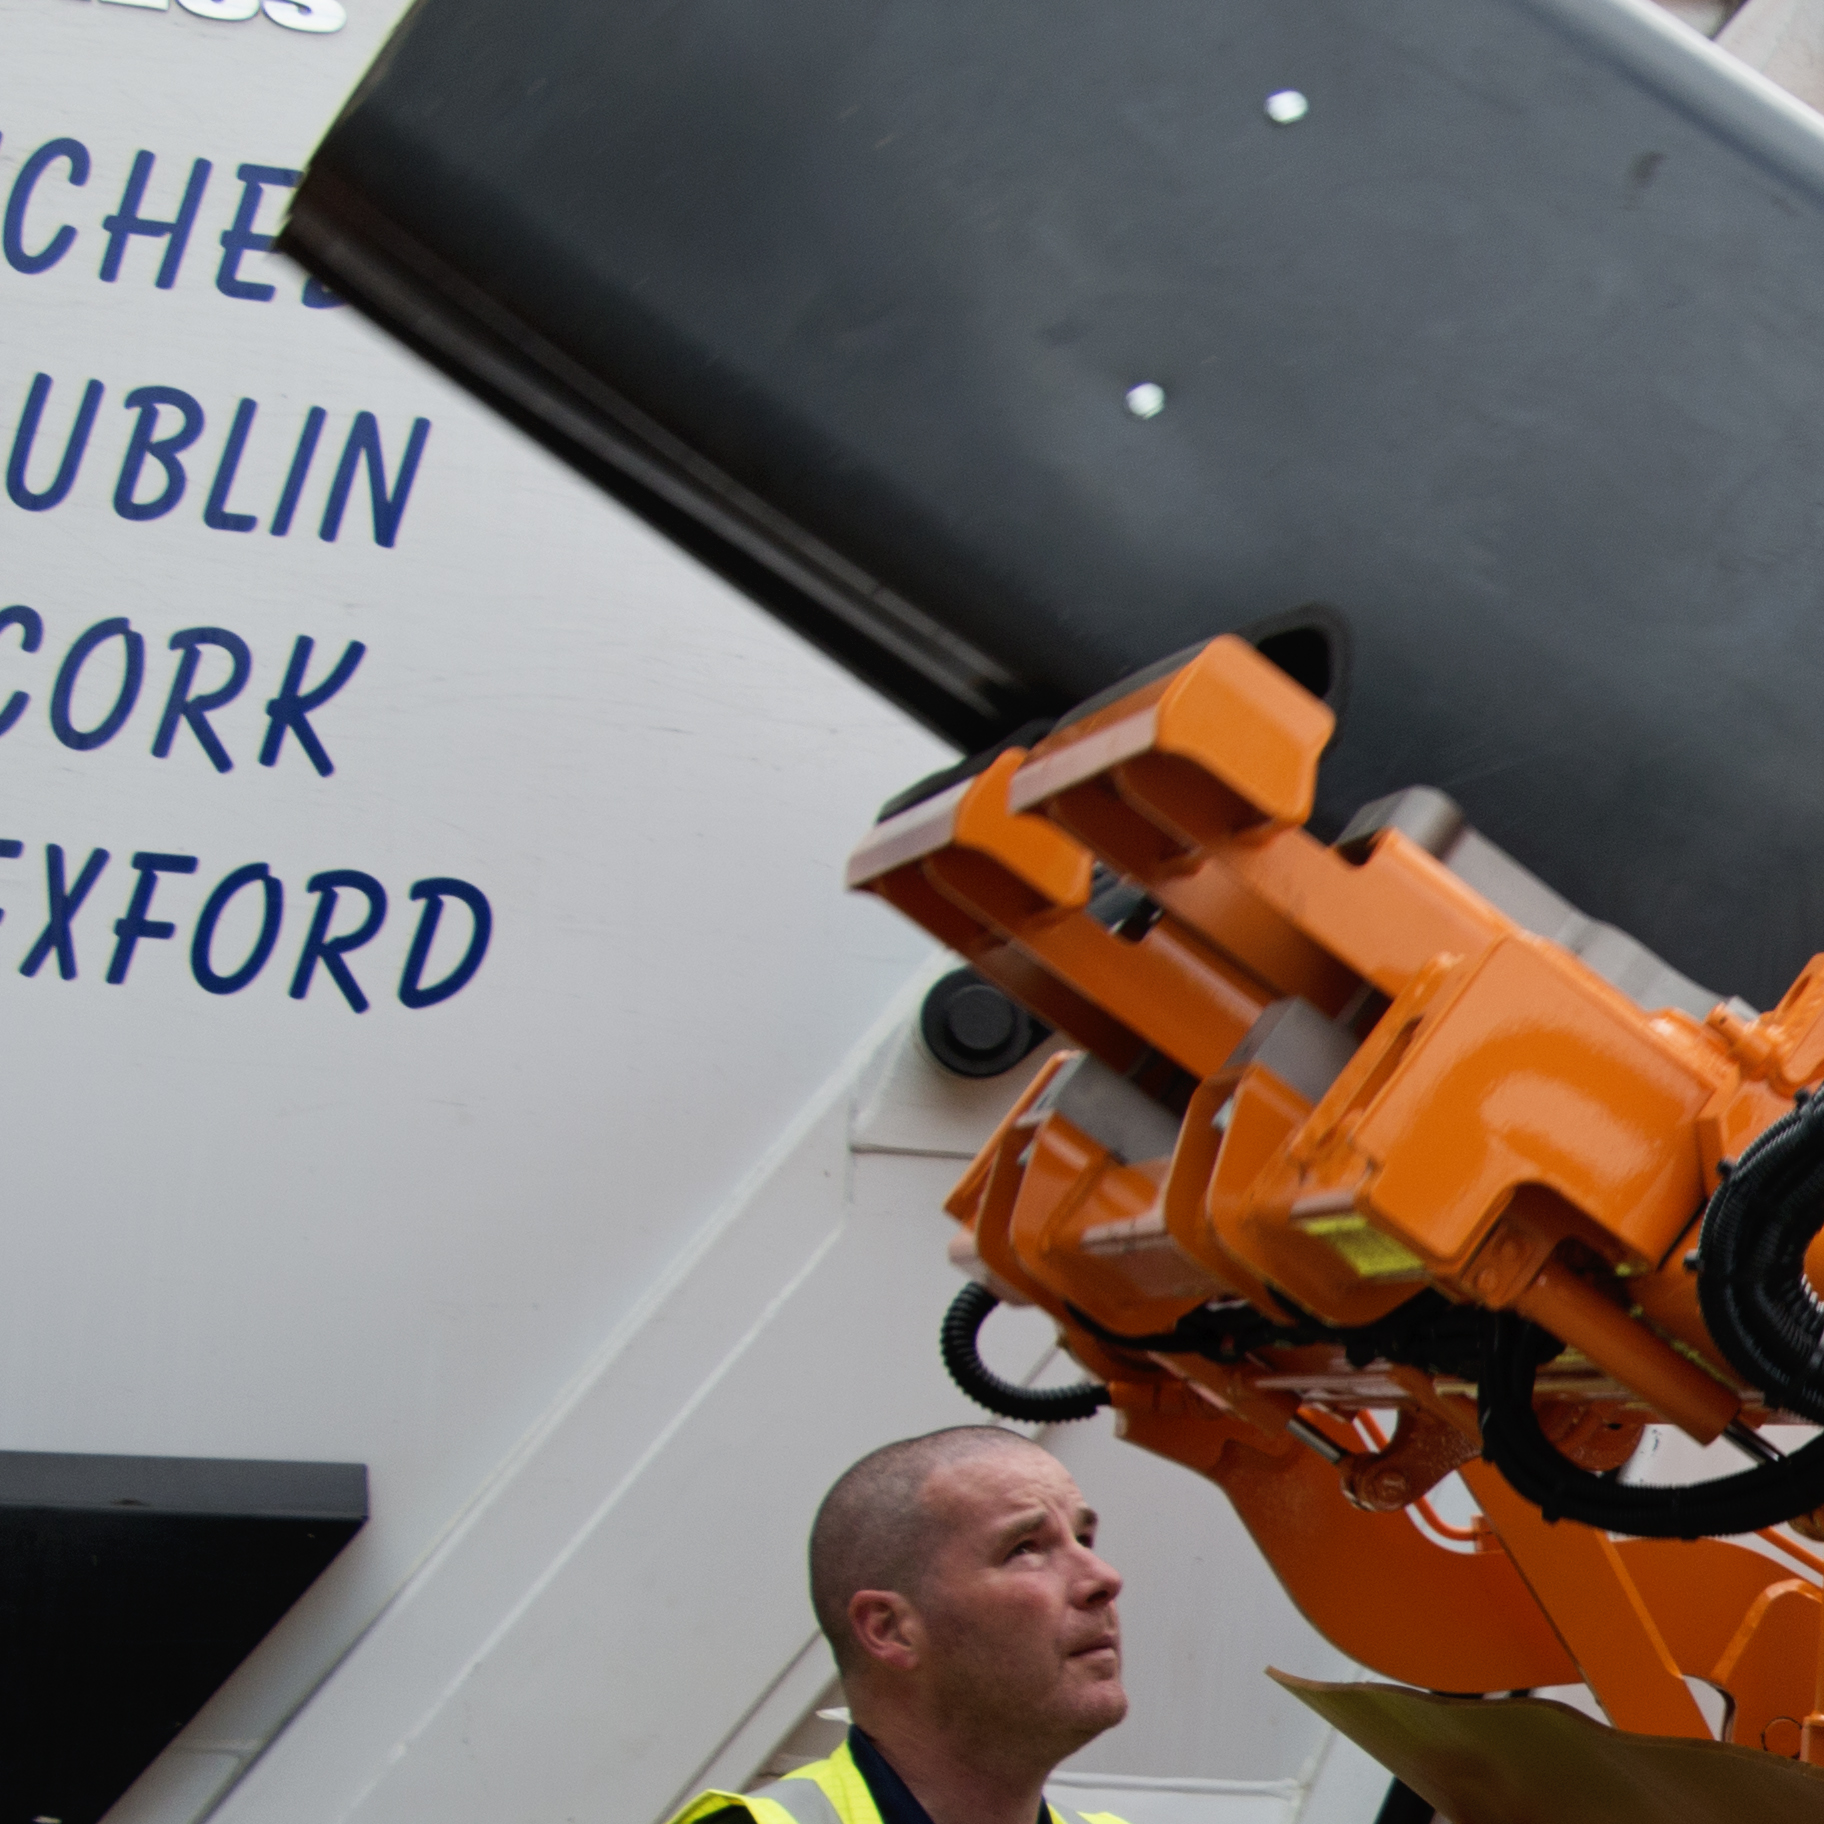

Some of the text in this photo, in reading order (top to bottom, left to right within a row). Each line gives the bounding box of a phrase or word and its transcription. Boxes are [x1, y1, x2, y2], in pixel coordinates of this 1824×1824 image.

[0, 134, 346, 309] CHE
[5, 372, 431, 548] UBLIN
[0, 838, 492, 1014] XFORD
